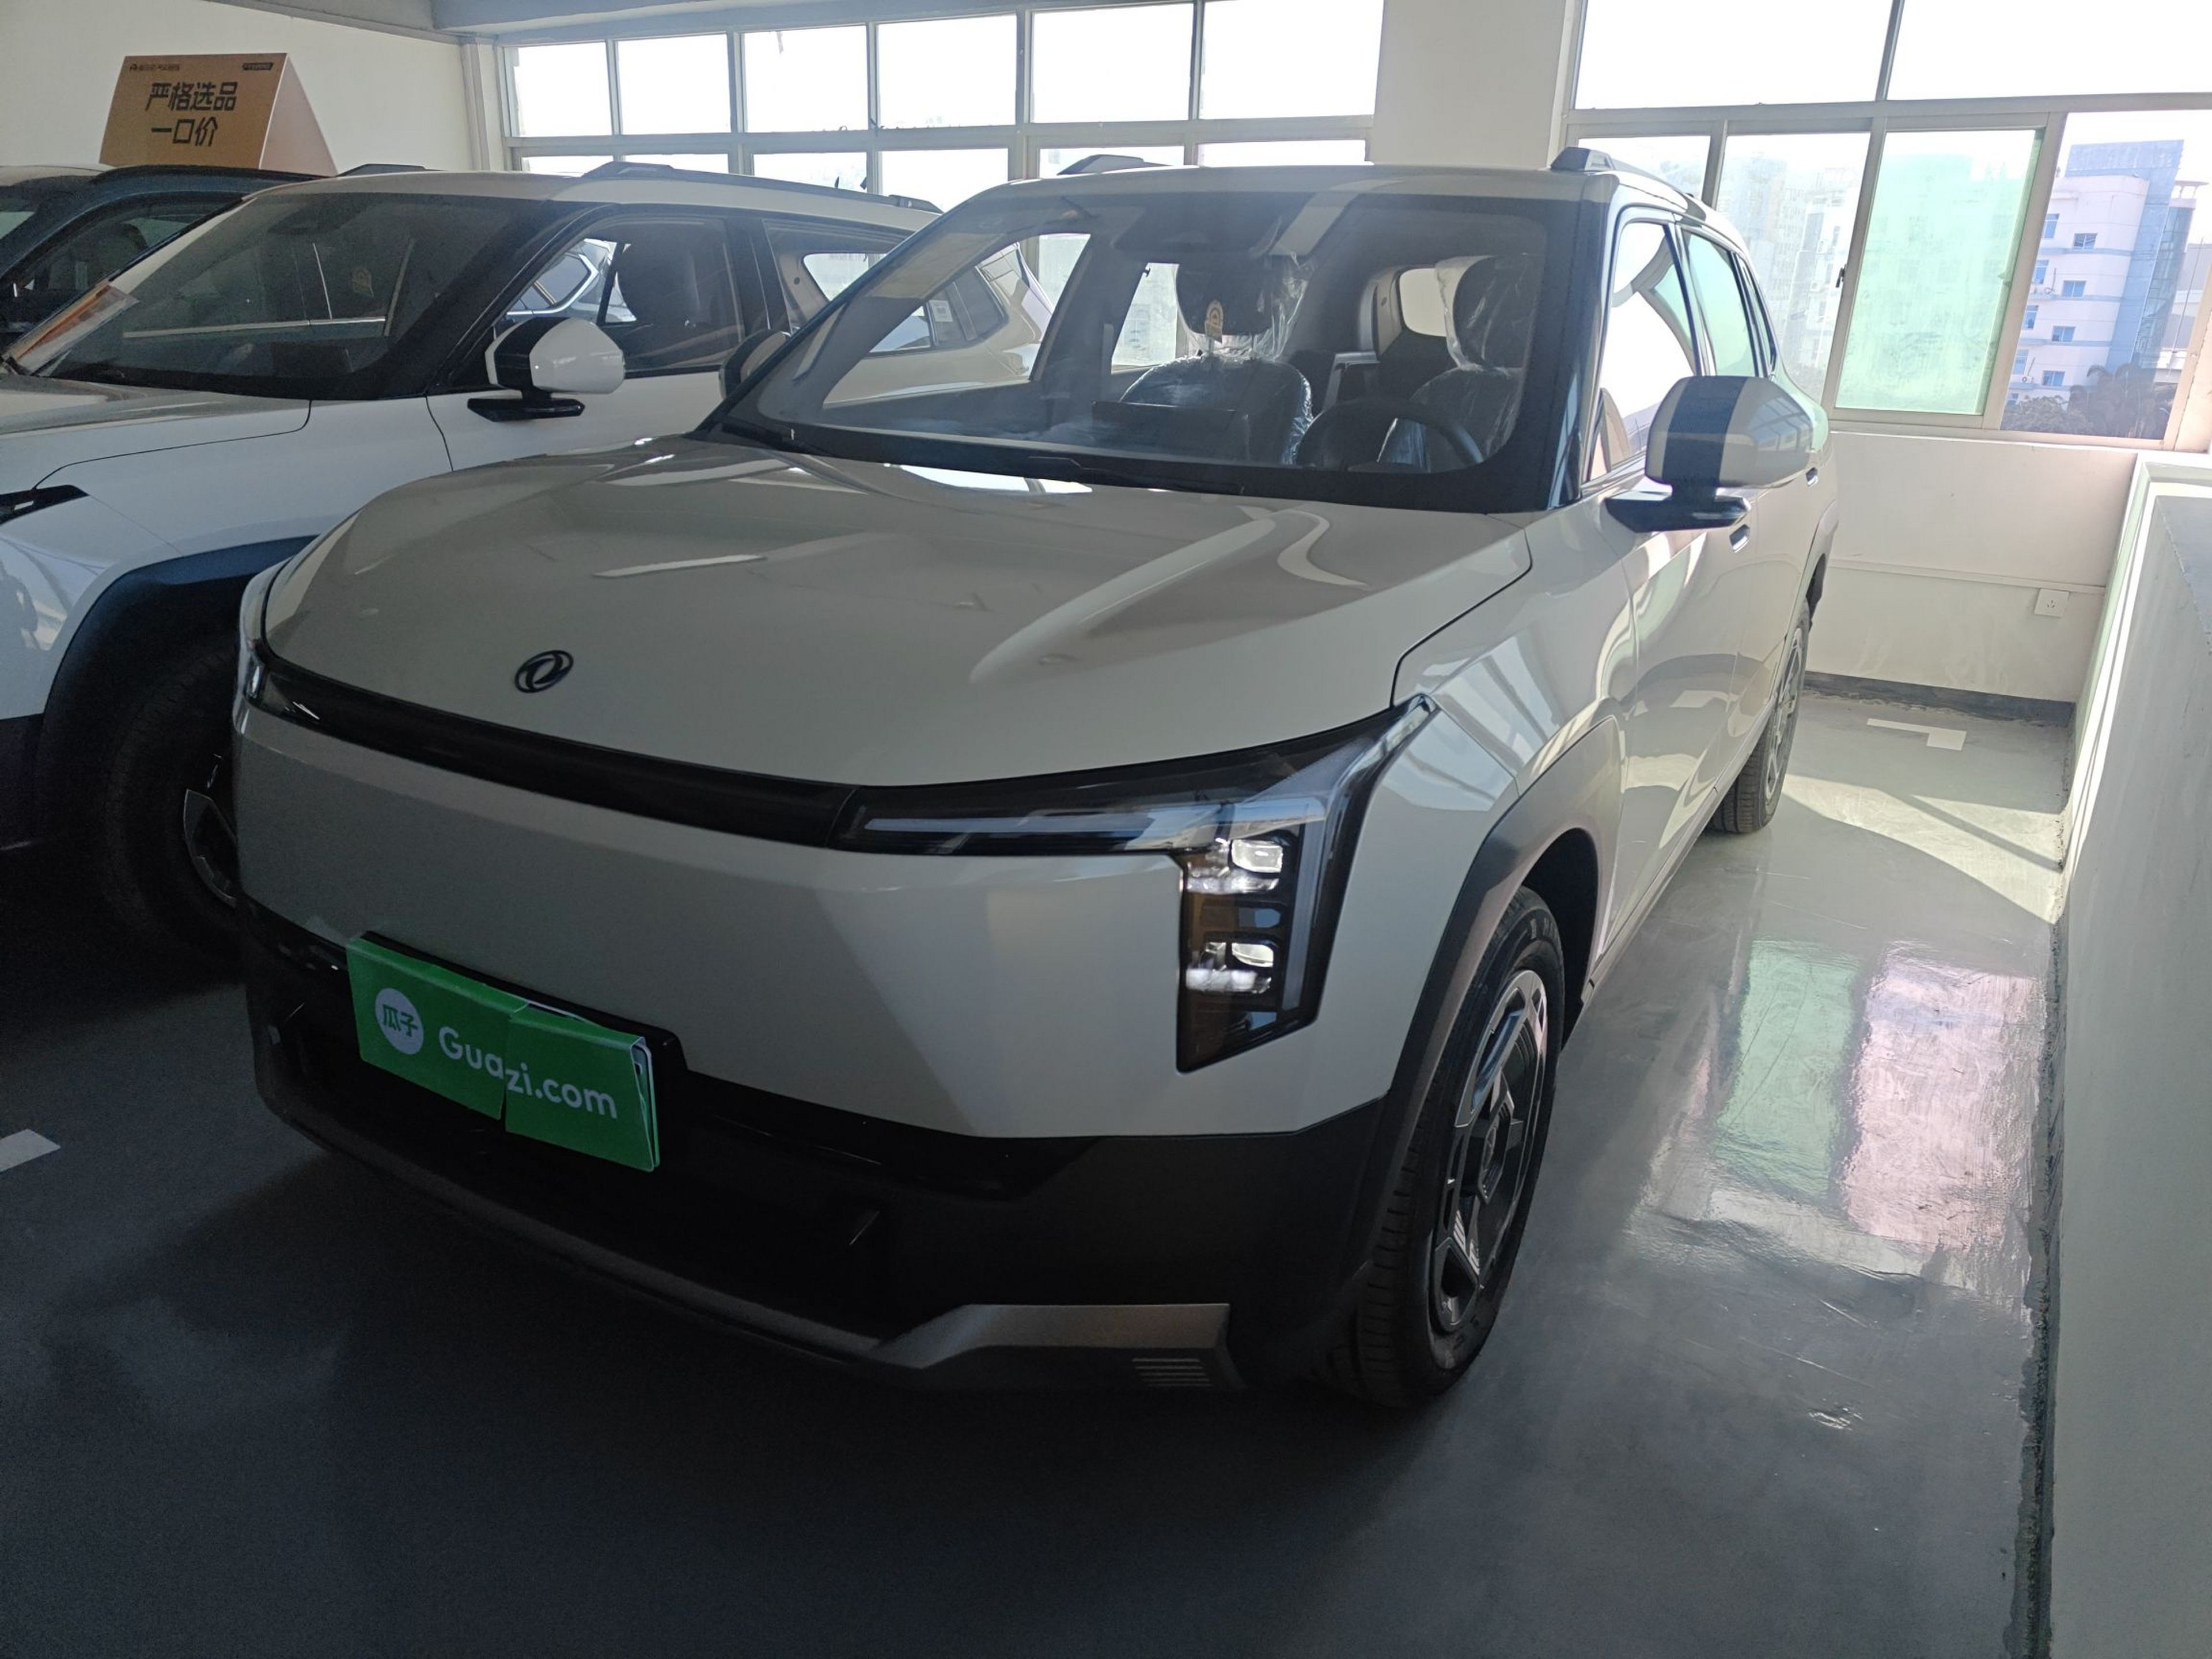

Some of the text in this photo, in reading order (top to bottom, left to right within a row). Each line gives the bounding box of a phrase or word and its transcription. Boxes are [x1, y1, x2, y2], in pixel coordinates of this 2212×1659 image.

[145, 81, 238, 112] 严格选品
[151, 116, 218, 147] 一口价
[382, 1005, 418, 1037] 瓜子
[438, 1026, 618, 1119] Guazi.com
